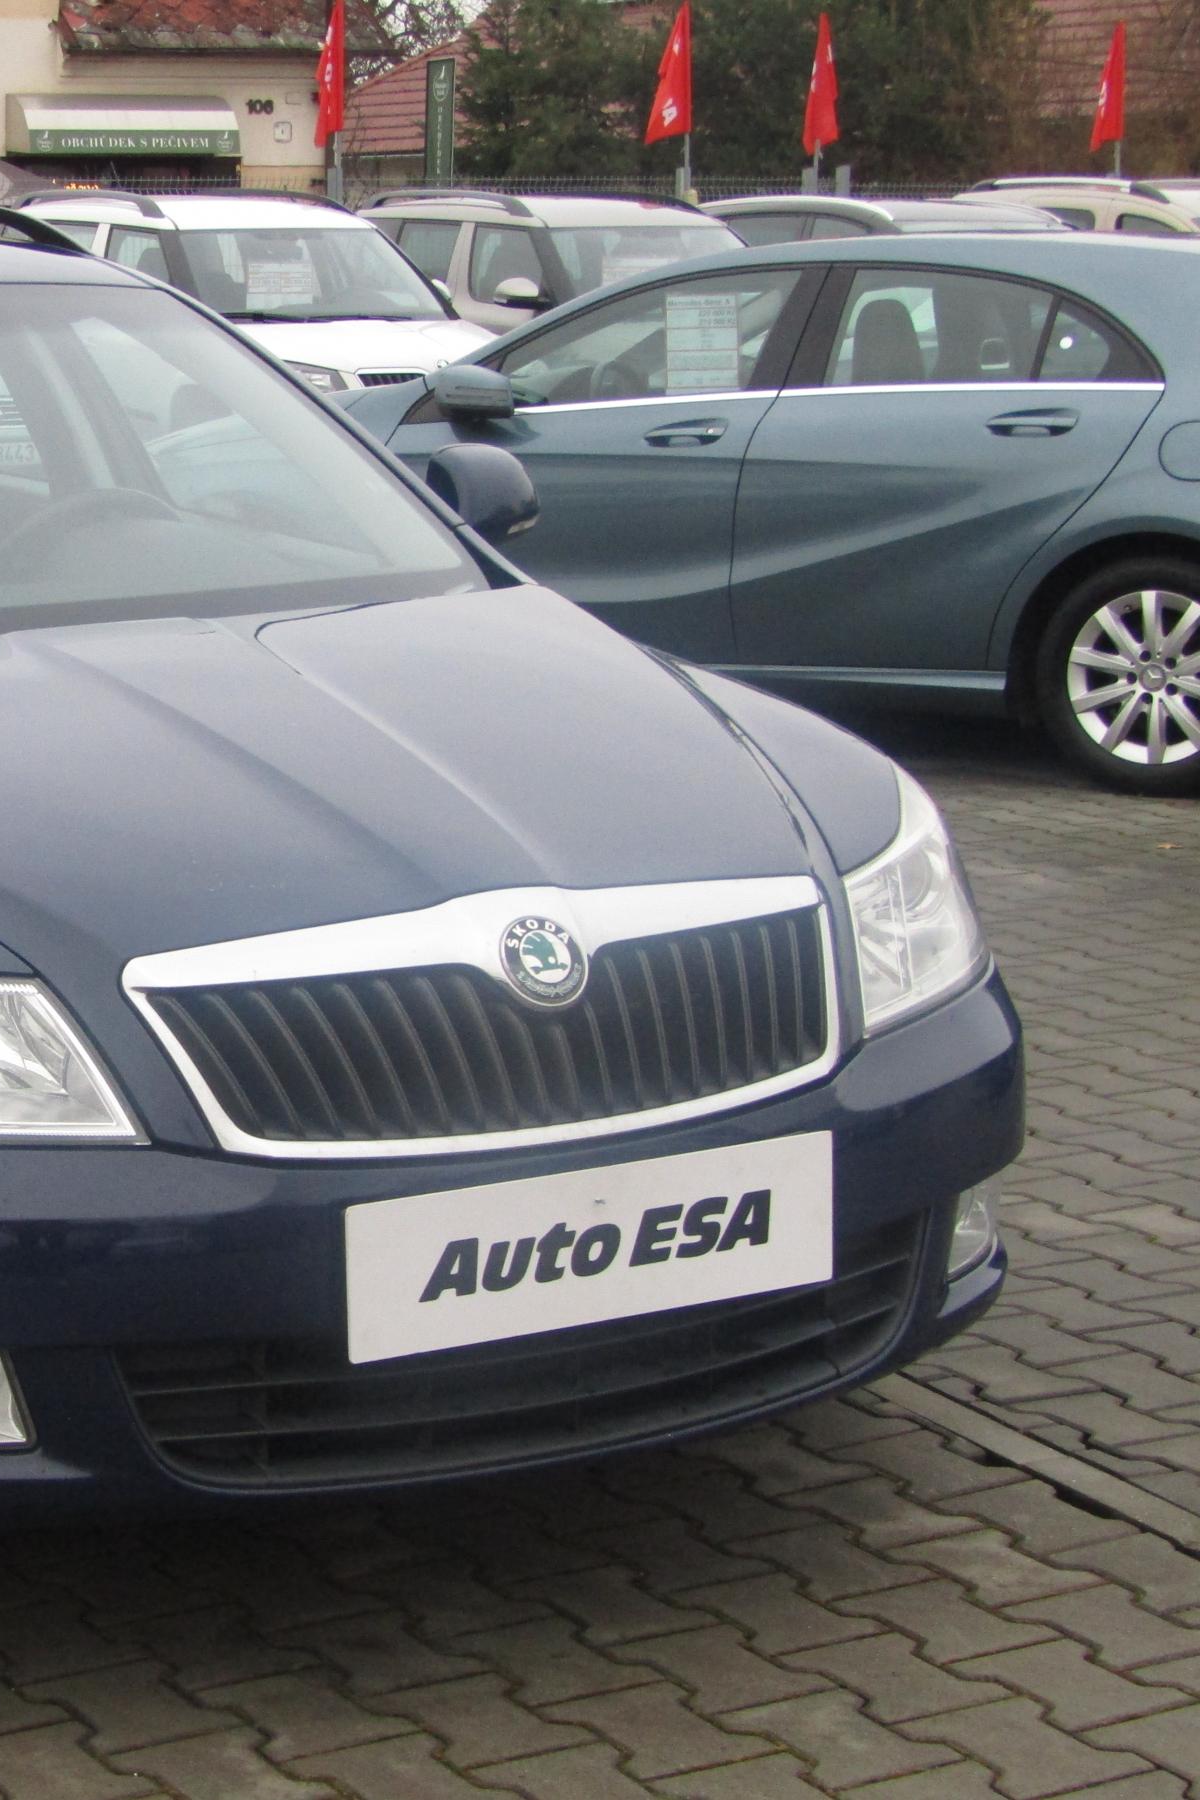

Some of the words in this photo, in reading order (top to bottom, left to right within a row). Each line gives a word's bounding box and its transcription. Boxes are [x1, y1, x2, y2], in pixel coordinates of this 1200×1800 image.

[246, 99, 274, 115] 106
[62, 135, 136, 148] OBCHŮDEK
[140, 138, 148, 148] S
[152, 135, 210, 148] PEČIVEM
[419, 1222, 622, 1302] Auto
[629, 1189, 771, 1267] ESA
